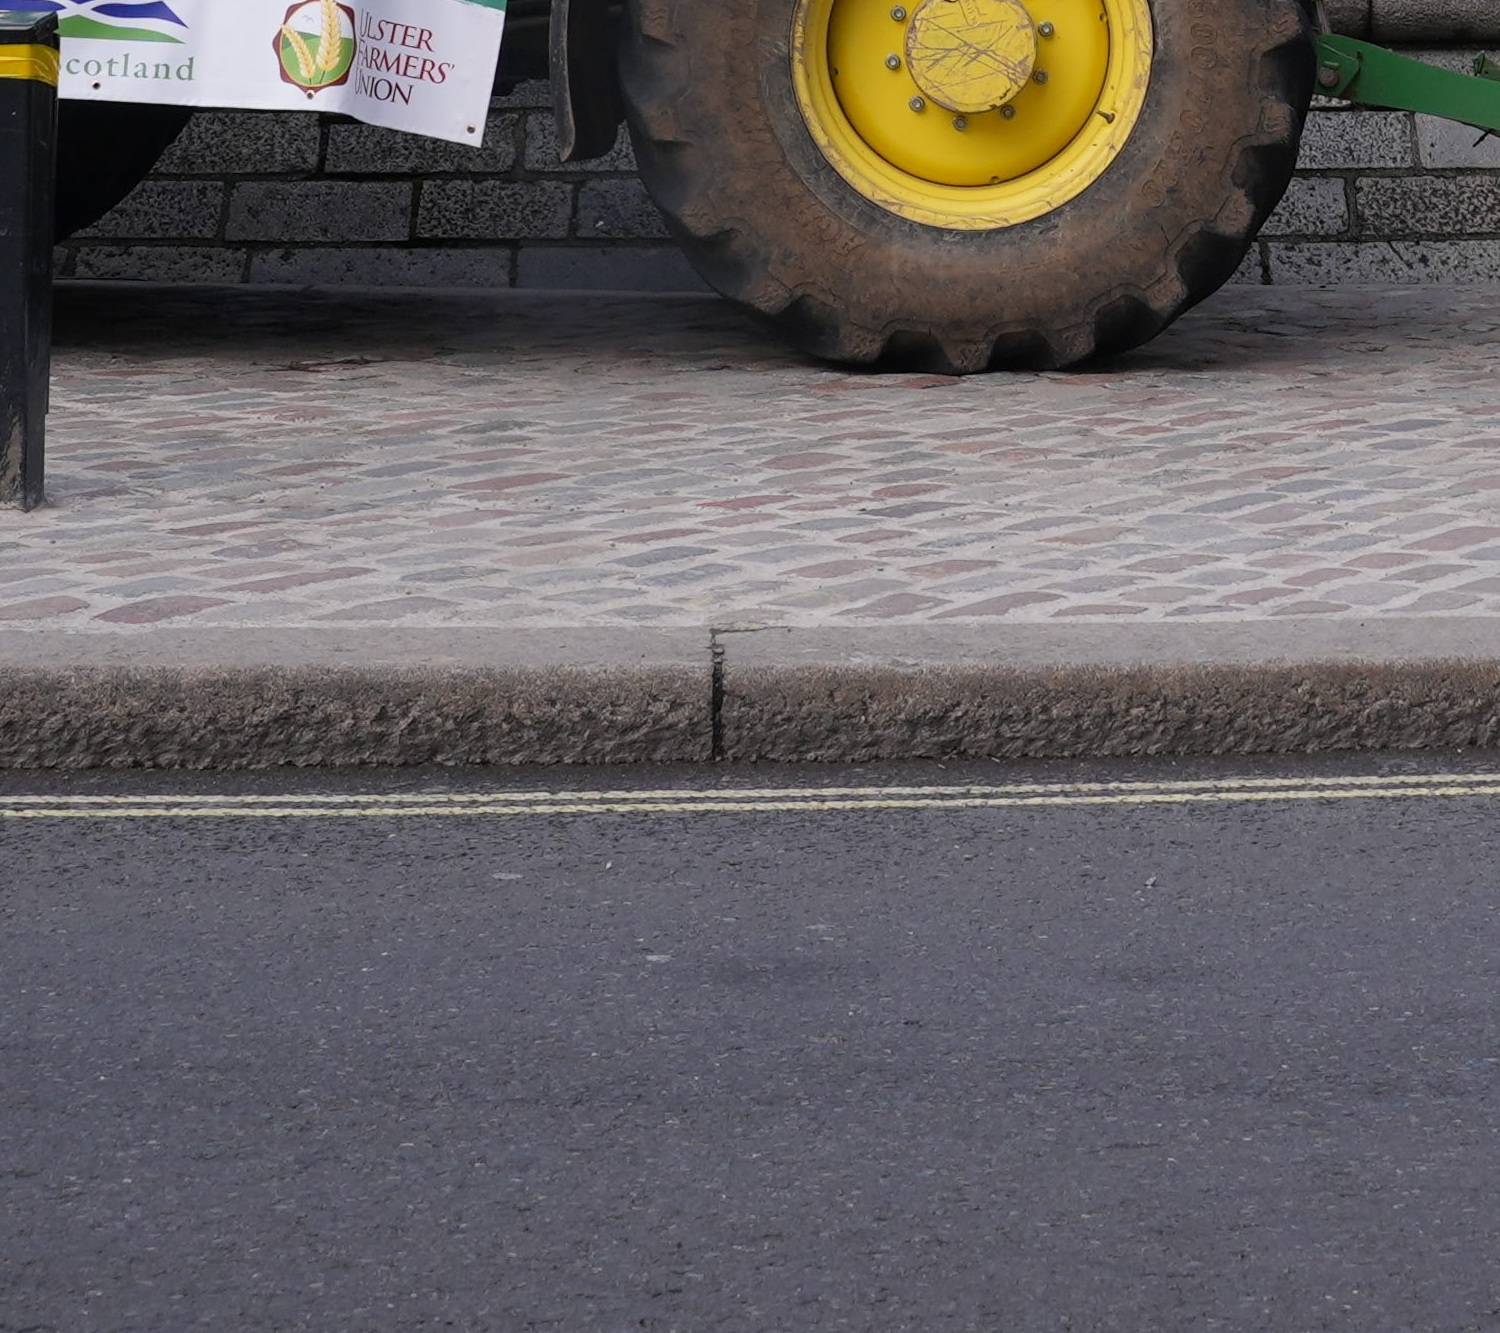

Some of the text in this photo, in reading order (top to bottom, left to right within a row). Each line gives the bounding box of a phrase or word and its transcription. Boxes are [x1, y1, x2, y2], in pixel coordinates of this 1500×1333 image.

[359, 7, 435, 53] ULSTER
[58, 52, 196, 82] cotland
[354, 66, 415, 107] UNION
